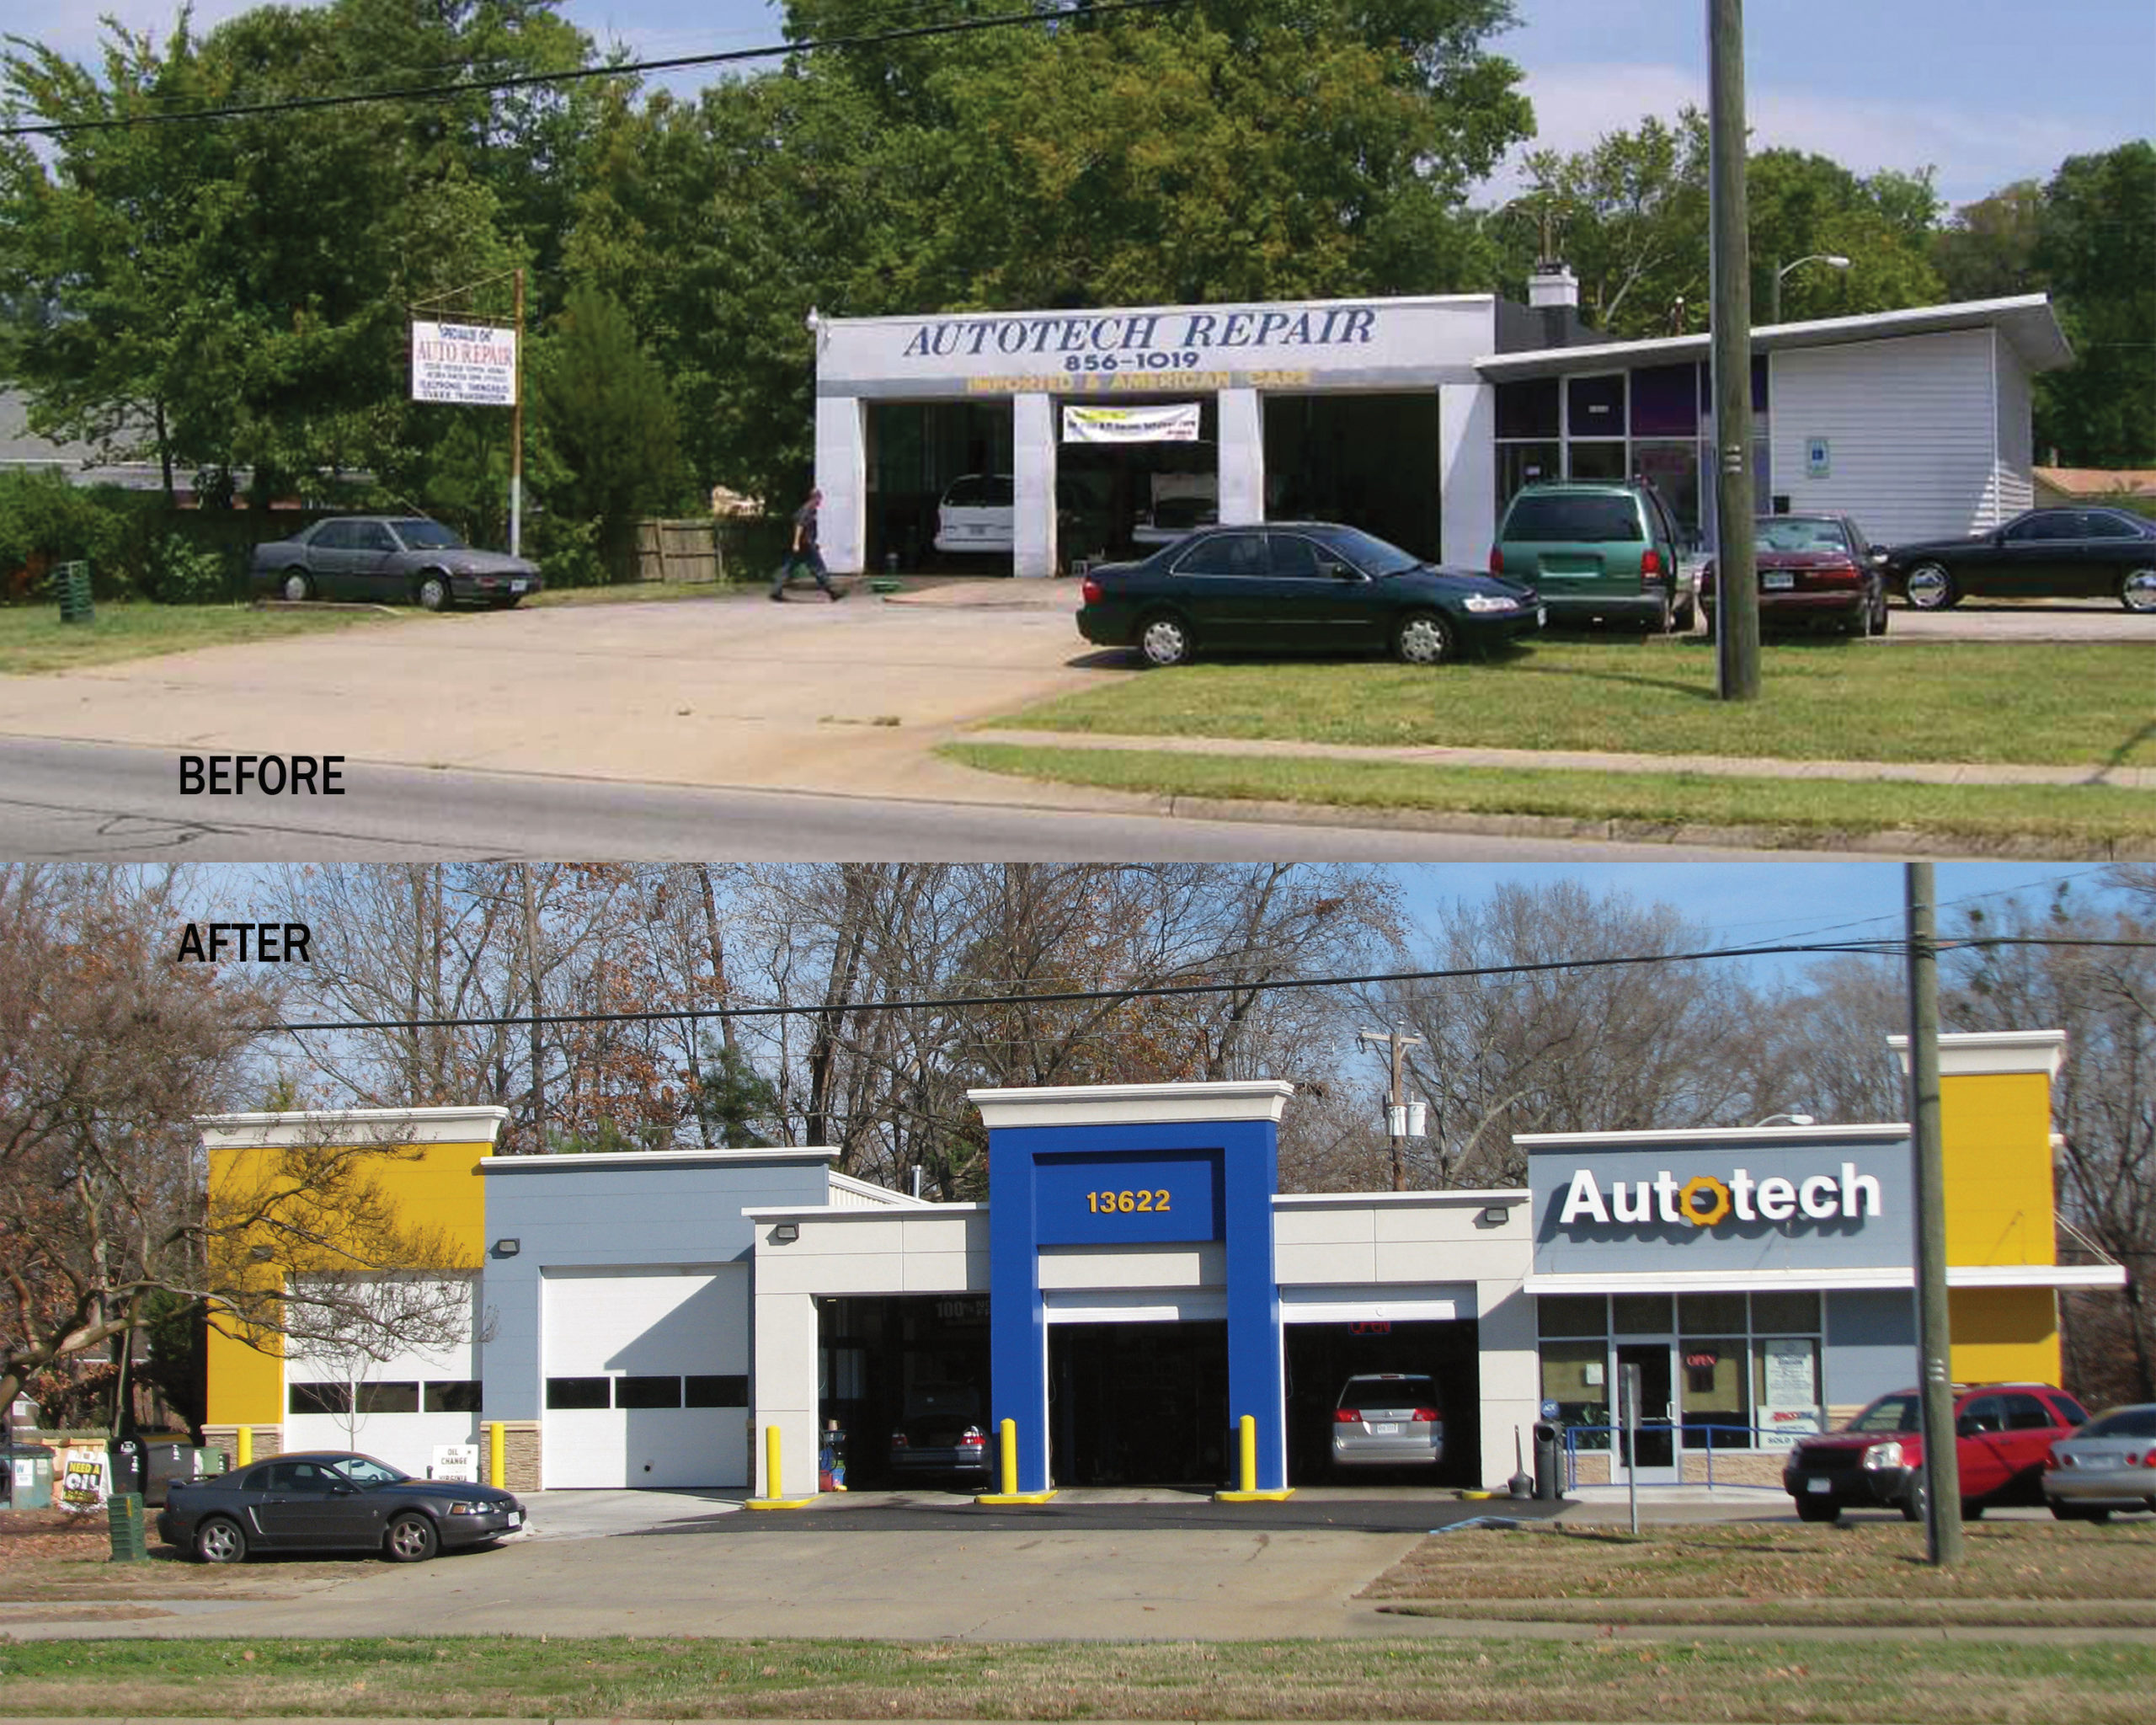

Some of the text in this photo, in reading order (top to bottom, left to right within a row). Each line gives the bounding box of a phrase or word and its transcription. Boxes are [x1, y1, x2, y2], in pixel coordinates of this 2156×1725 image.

[903, 307, 1375, 357] AUTOTECH REPAIR
[419, 340, 513, 367] AUTO REPAIR
[1064, 351, 1200, 371] 856-1019
[1110, 371, 1230, 391] AMERICAN
[1086, 1189, 1171, 1214] 13622
[1559, 1162, 1881, 1226] Autotech
[1686, 1354, 1716, 1366] OPEN
[447, 1448, 459, 1456] OIL
[69, 1461, 100, 1475] NEED A
[66, 1473, 99, 1491] OIL
